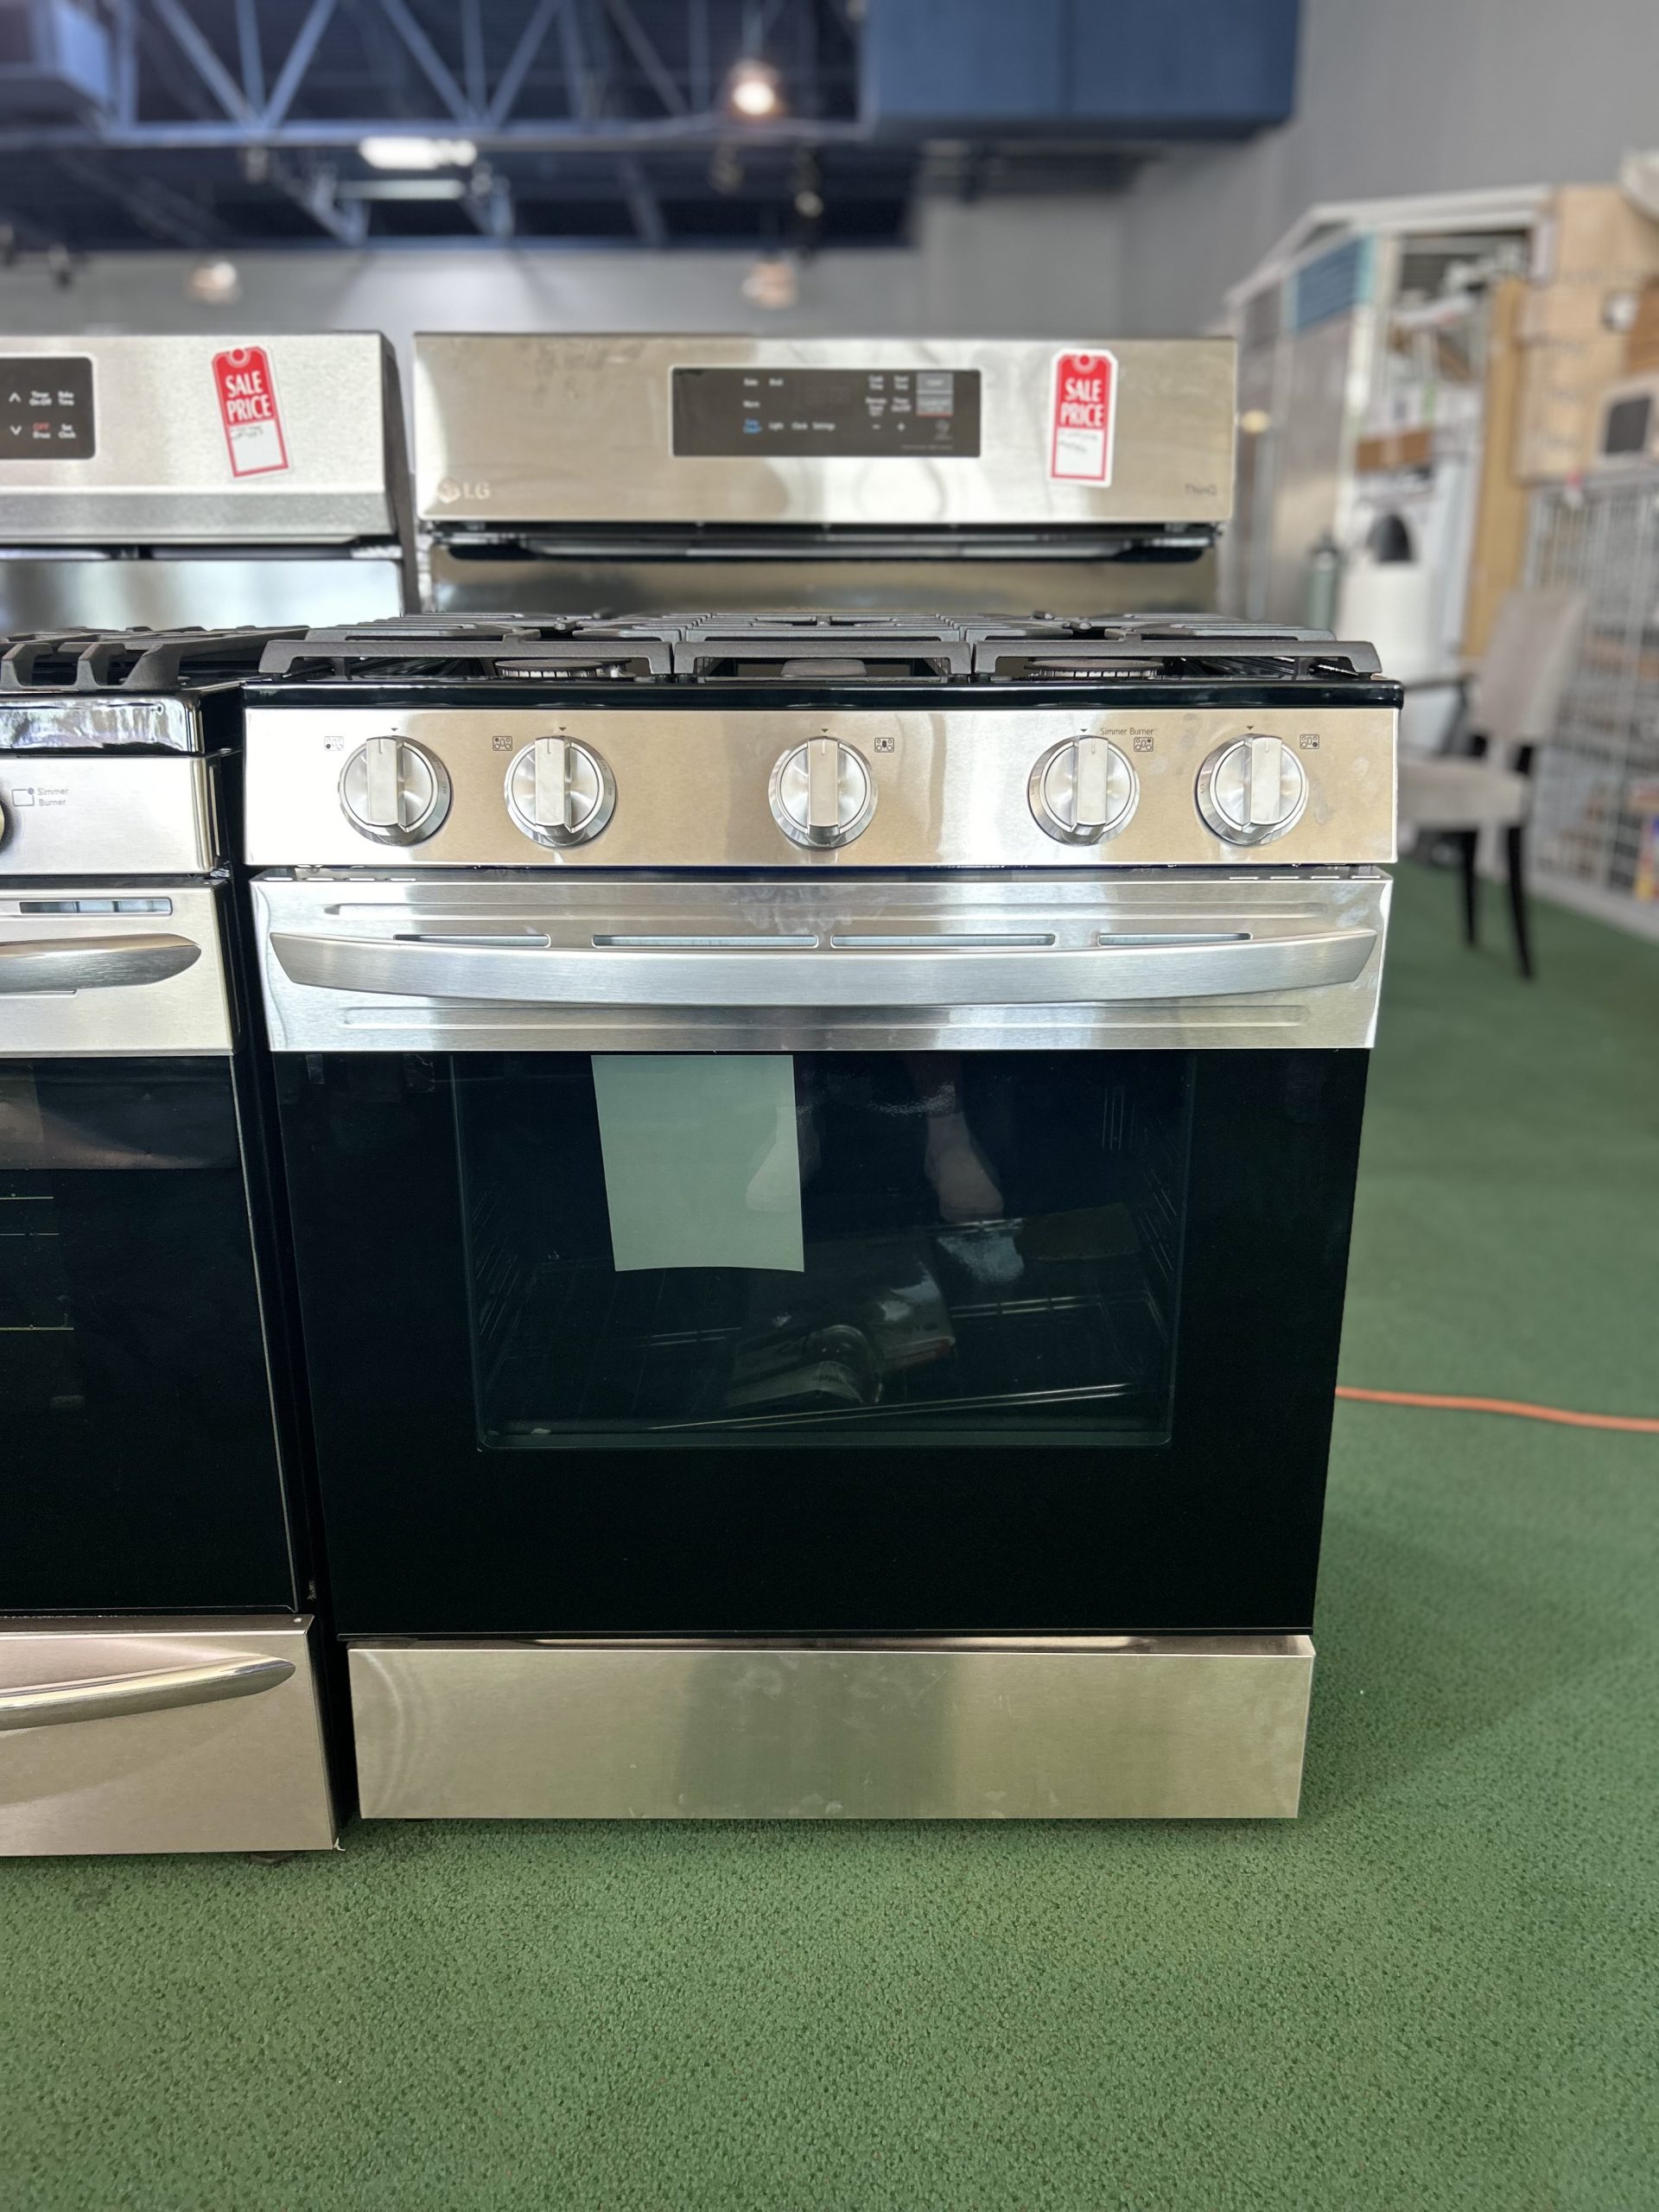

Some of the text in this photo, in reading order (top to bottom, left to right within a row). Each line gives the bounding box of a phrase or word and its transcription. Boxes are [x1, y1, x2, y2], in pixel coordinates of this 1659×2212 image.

[225, 370, 264, 397] SALE
[1065, 377, 1102, 402] SALE
[226, 394, 272, 423] PRICE
[1060, 402, 1105, 427] PRICE
[463, 482, 491, 500] LG
[1129, 727, 1154, 735] Burner
[39, 798, 66, 807] Burner
